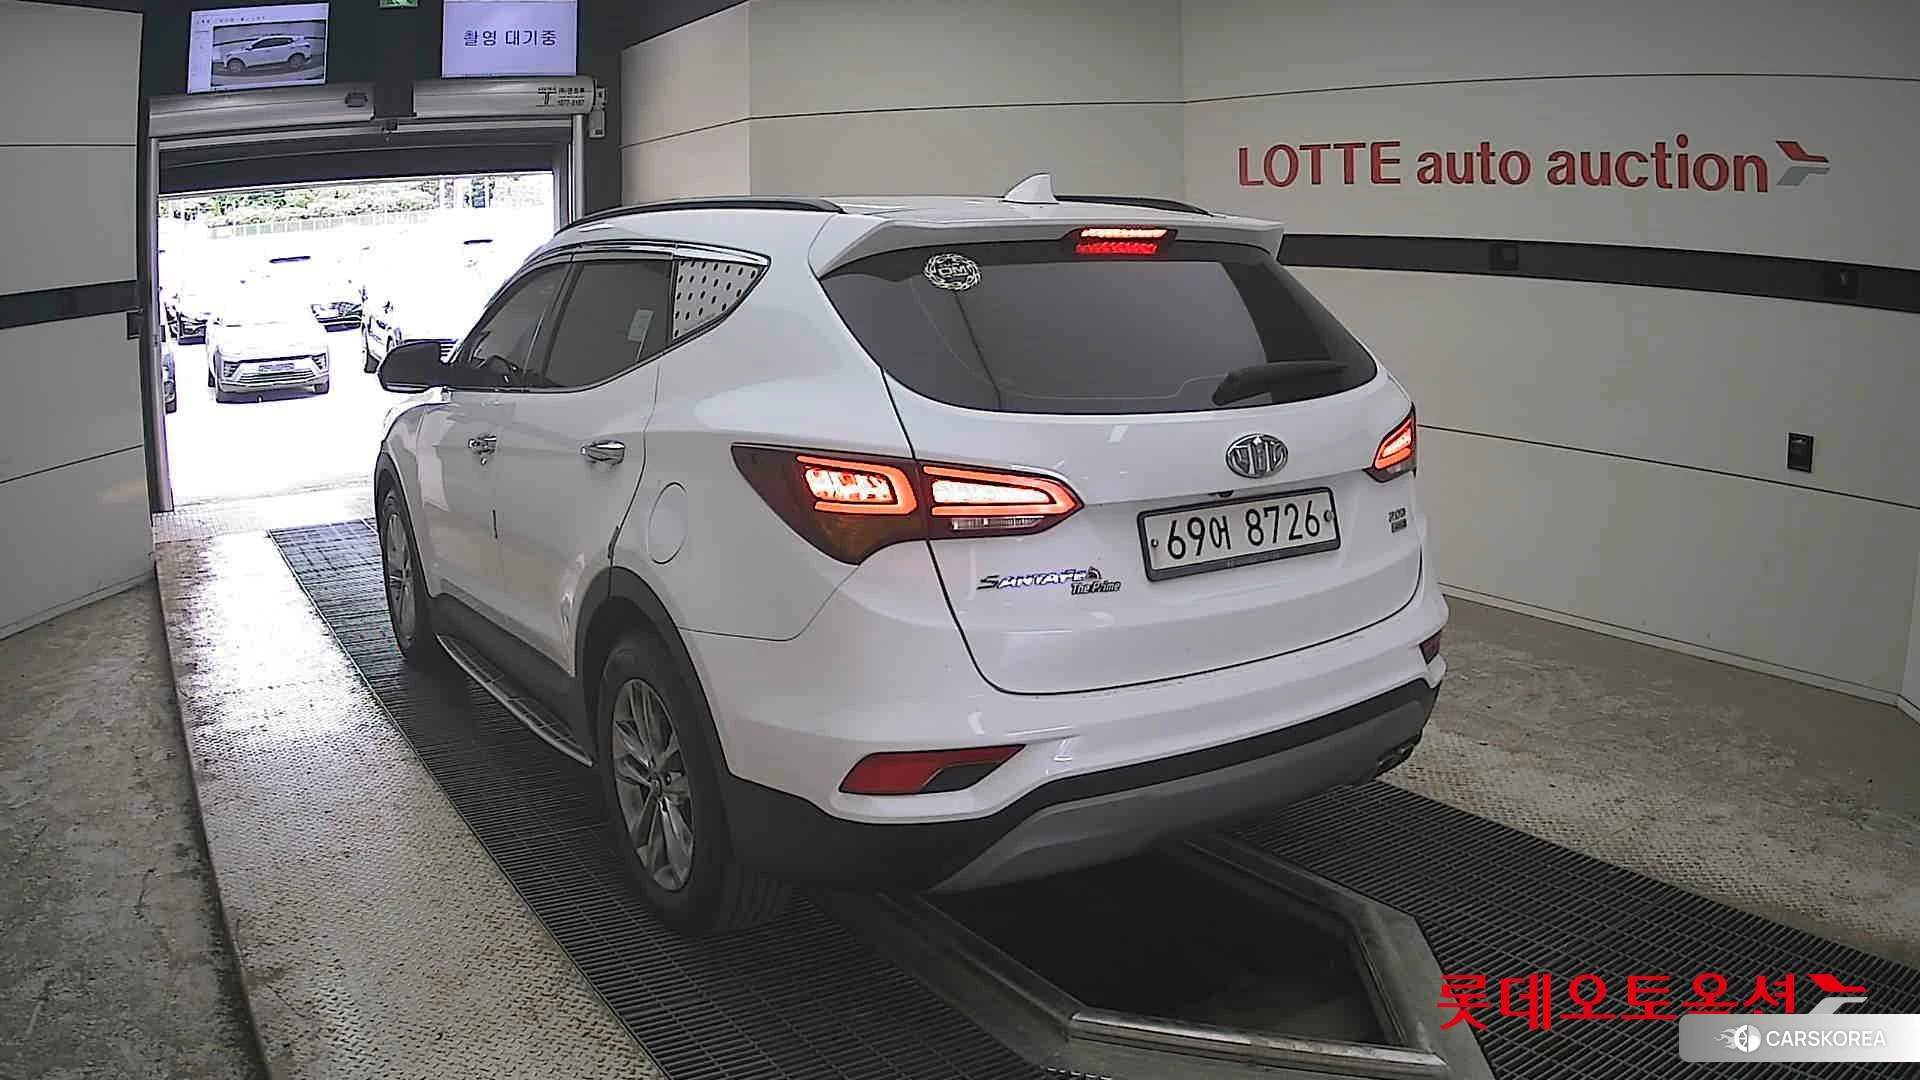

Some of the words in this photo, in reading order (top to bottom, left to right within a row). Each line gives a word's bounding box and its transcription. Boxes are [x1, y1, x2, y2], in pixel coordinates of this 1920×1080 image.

[463, 30, 497, 47] 촬영
[505, 29, 557, 47] 대기중
[1238, 140, 1401, 188] LOTTE
[1416, 141, 1532, 186] auto
[1546, 133, 1769, 193] auction
[1167, 515, 1232, 560] 69어
[1245, 500, 1321, 546] 8726
[1071, 580, 1091, 595] The
[1091, 580, 1121, 594] Prime
